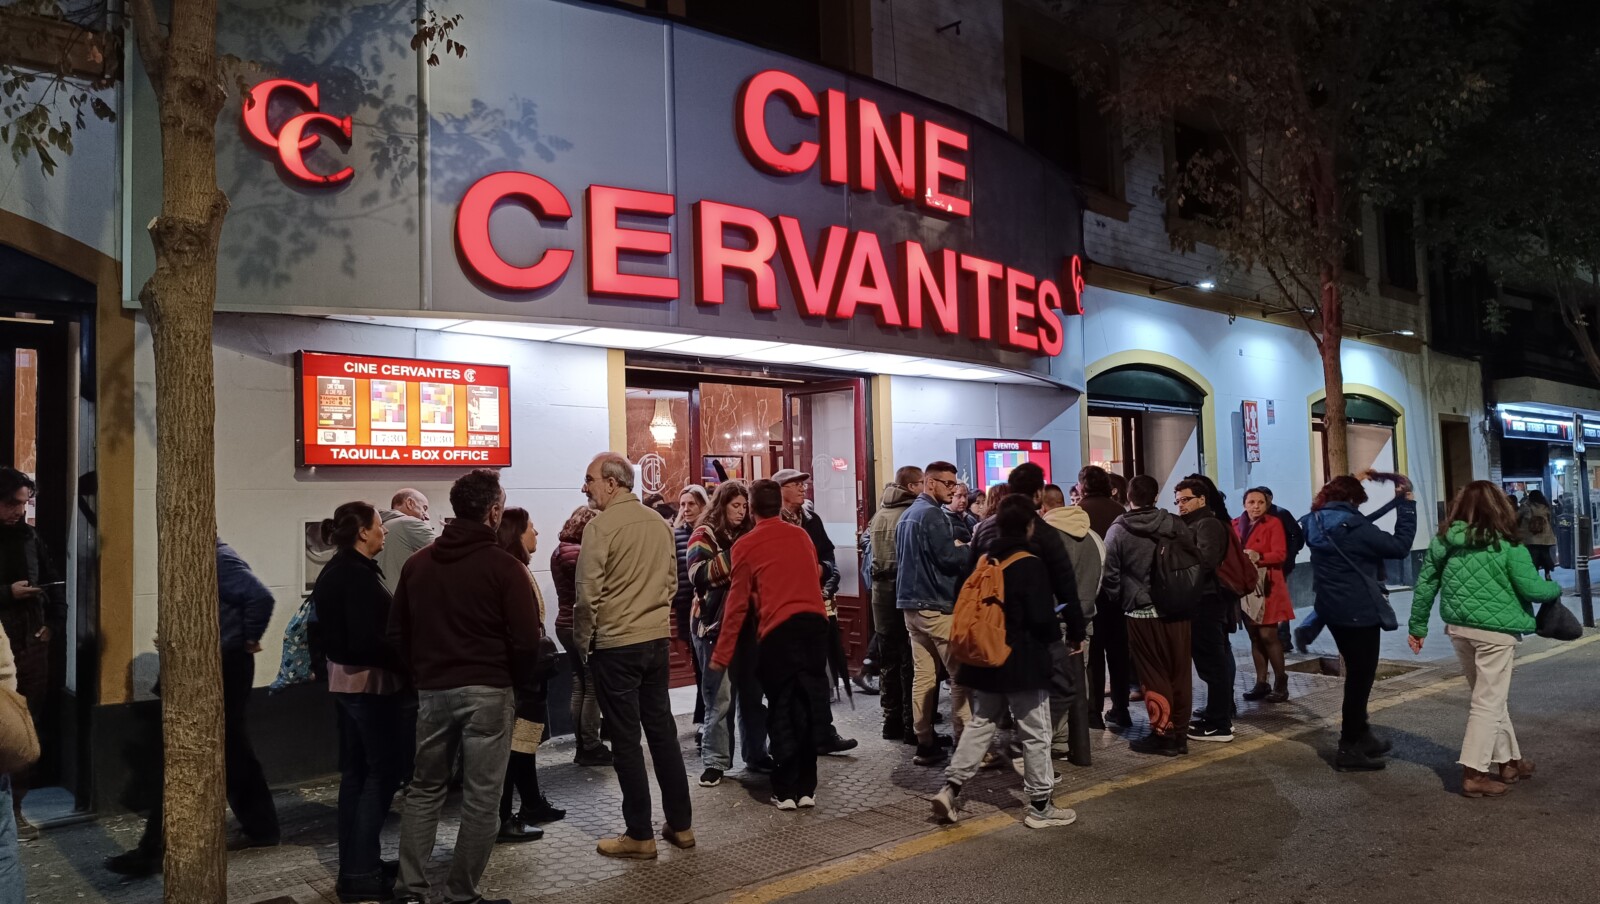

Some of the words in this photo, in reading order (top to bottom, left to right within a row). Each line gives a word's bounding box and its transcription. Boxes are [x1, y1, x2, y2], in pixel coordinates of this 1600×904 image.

[737, 69, 971, 217] CINE
[456, 170, 1065, 357] CERVANTES
[344, 362, 377, 375] CINE
[381, 364, 461, 380] CERVANTES
[374, 433, 404, 443] 17:30
[993, 442, 1020, 450] EVENTOS
[330, 448, 401, 460] TAQUILLA
[412, 450, 440, 461] BOX
[443, 450, 489, 461] OFFICE
